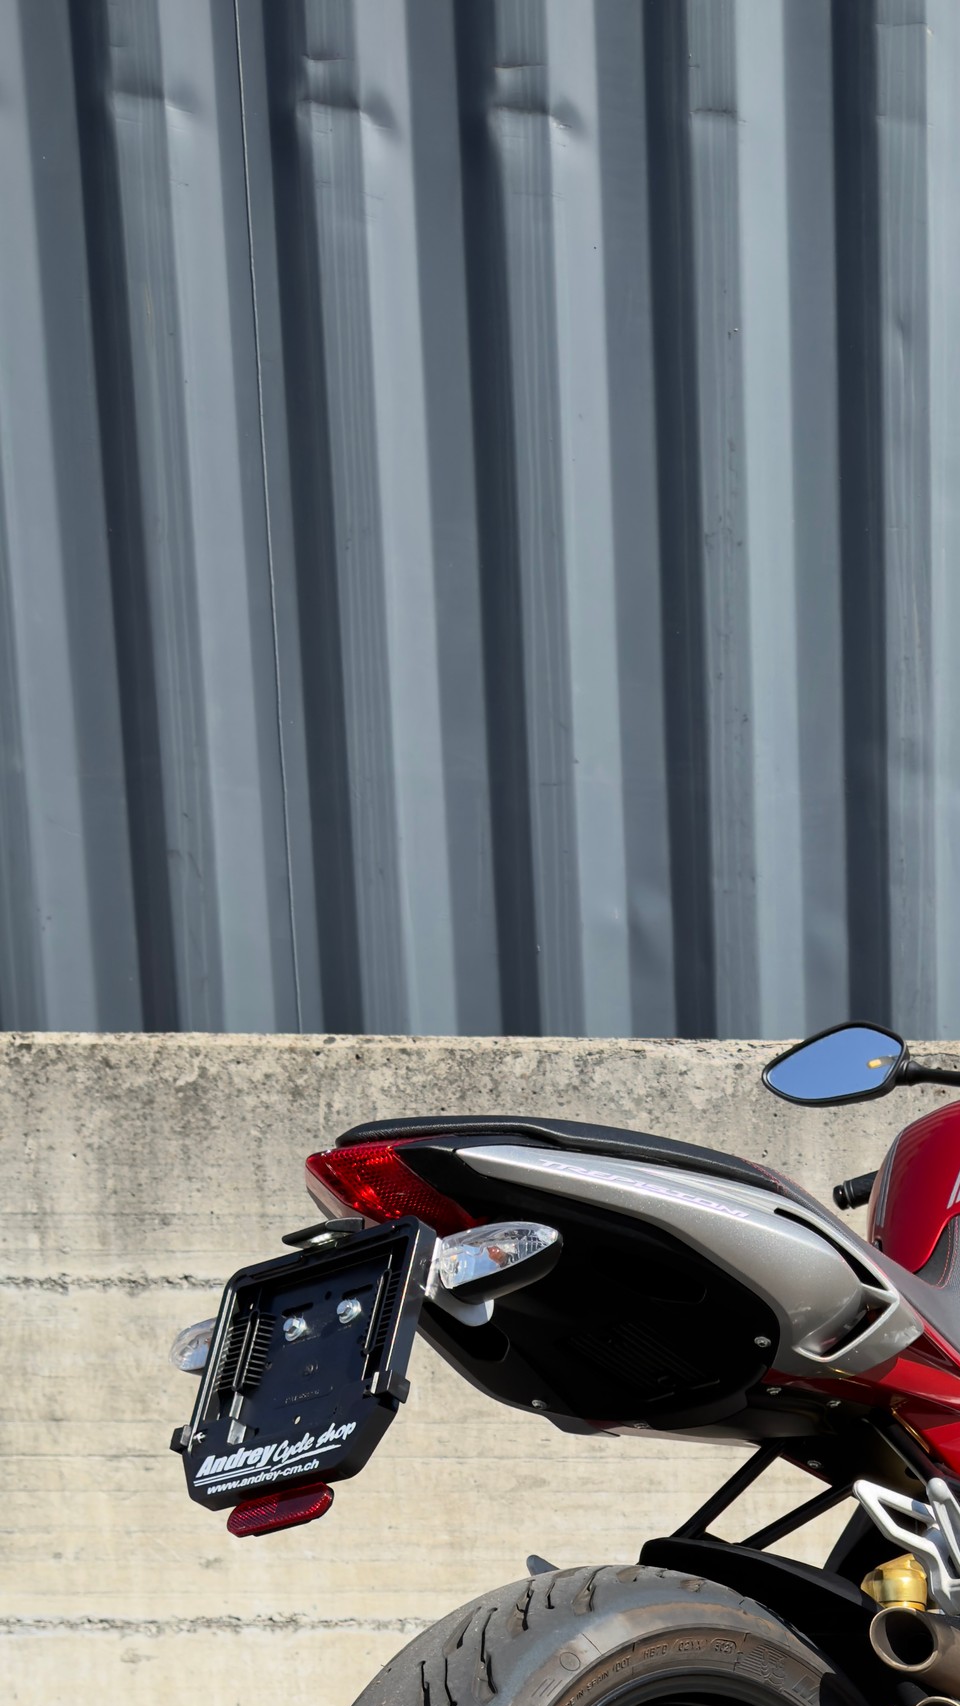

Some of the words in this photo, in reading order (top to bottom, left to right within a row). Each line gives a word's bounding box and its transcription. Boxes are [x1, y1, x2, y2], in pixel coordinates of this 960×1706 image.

[195, 1443, 278, 1479] Andrey
[272, 1432, 315, 1464] Cycle
[315, 1421, 357, 1449] shop
[206, 1458, 320, 1495] www.andrey-cm.ch
